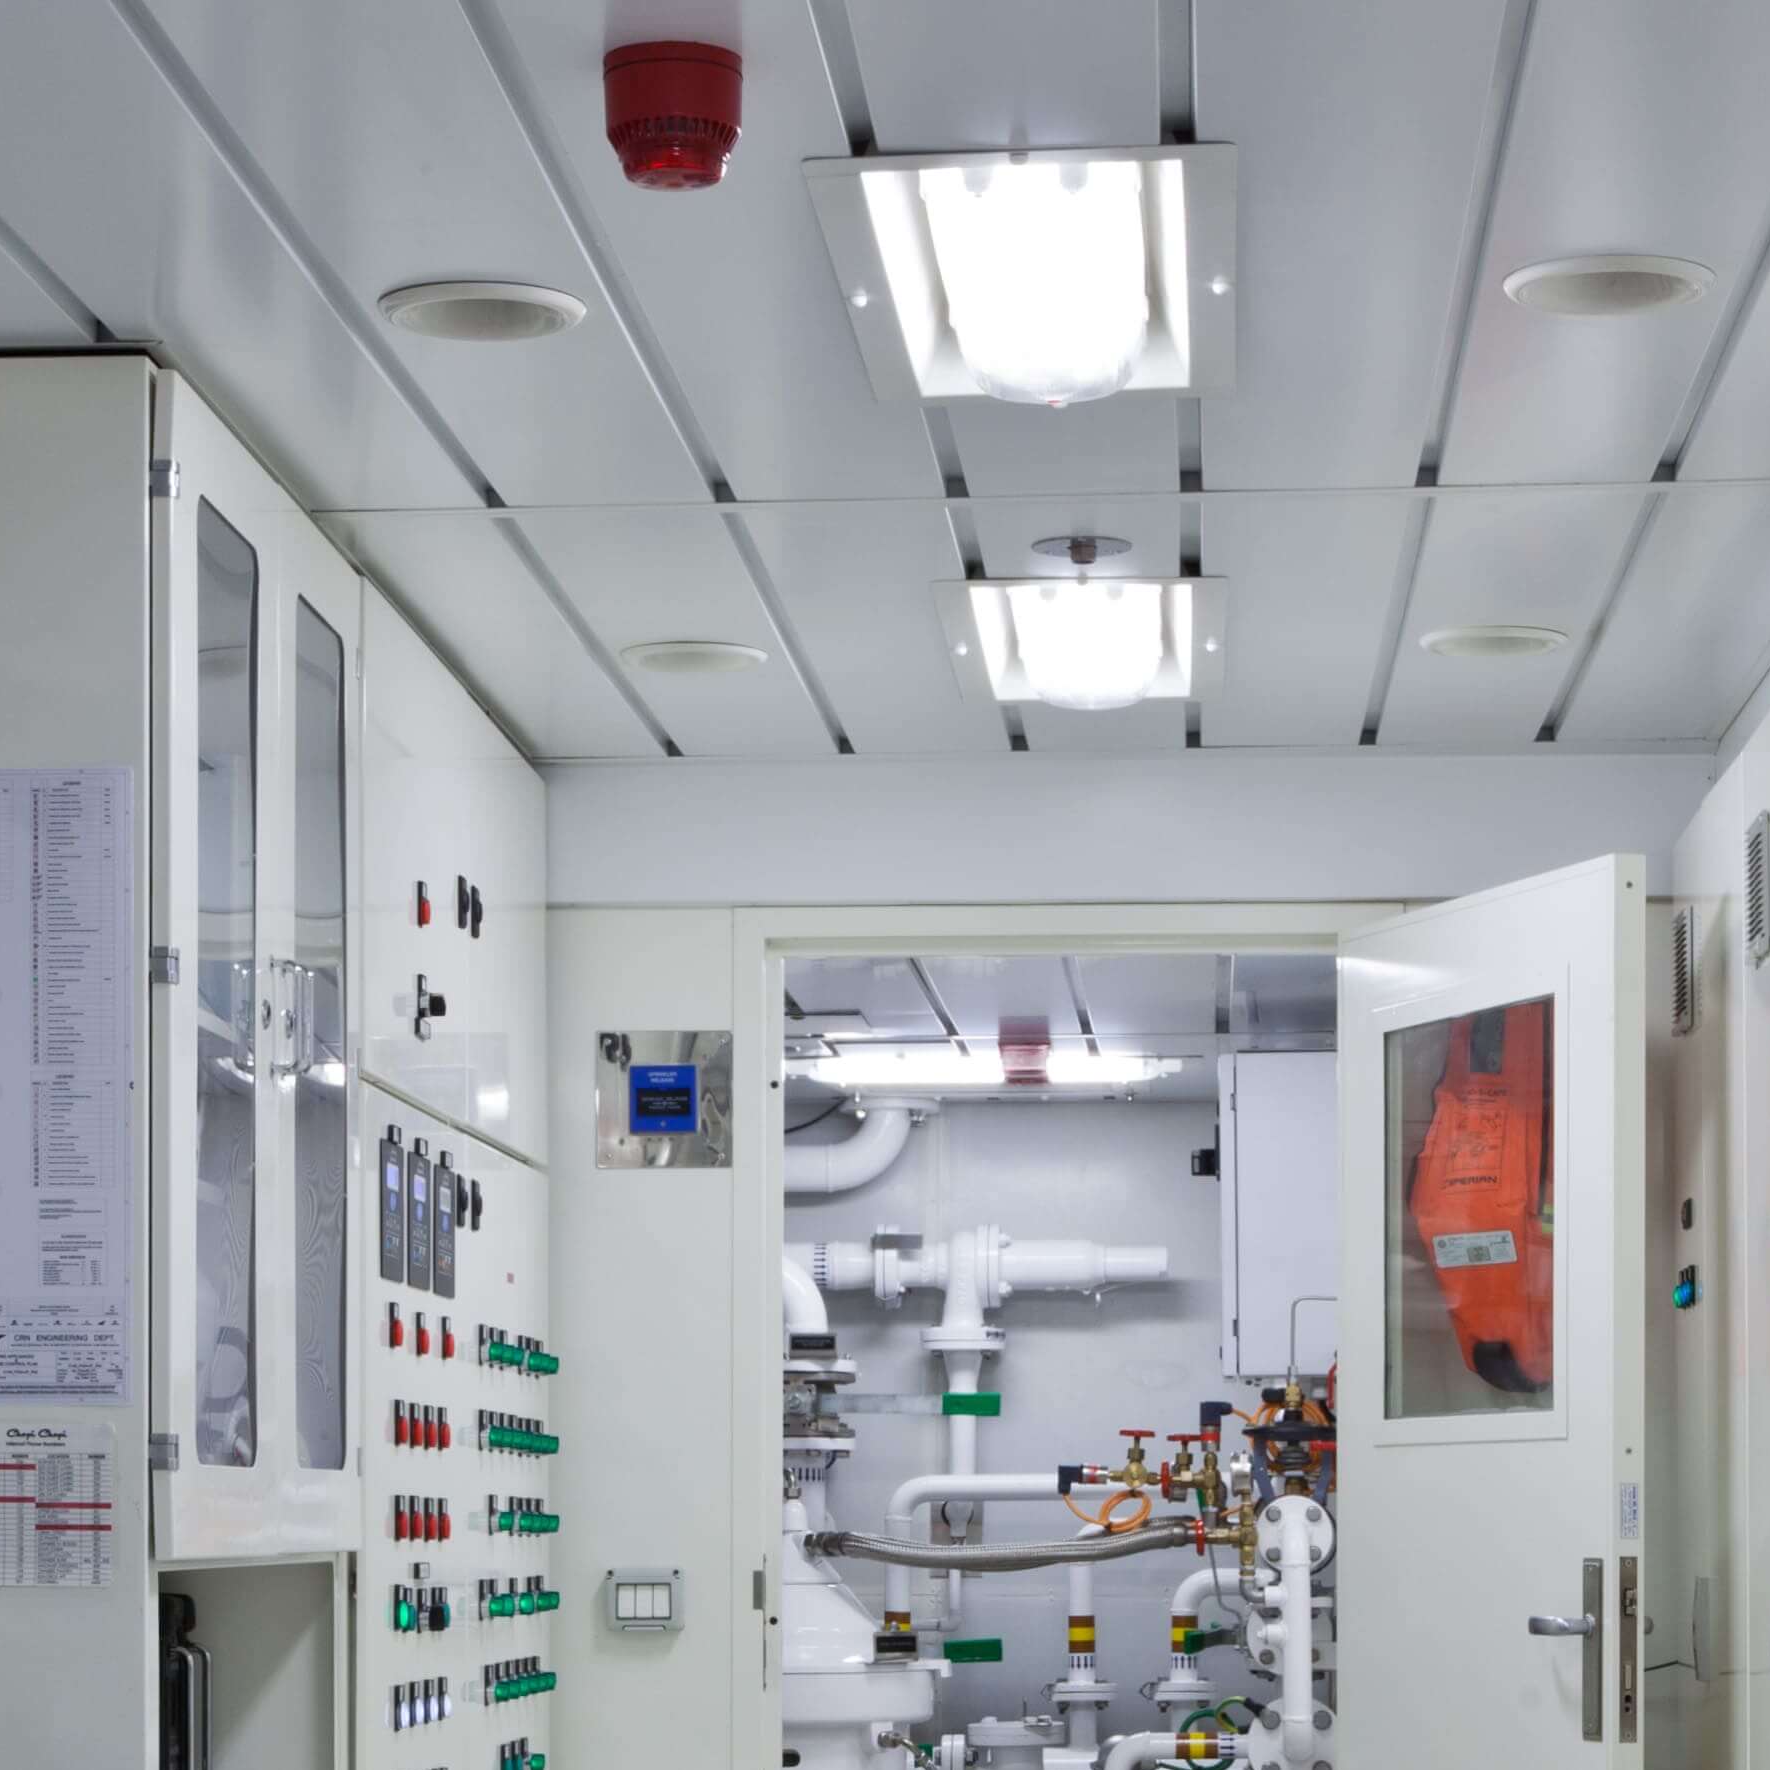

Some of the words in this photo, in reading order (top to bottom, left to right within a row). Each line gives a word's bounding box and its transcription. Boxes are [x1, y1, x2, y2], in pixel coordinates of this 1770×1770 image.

[14, 1334, 31, 1342] CRN
[36, 1334, 88, 1342] ENGINEERING
[94, 1334, 115, 1342] DEPT
